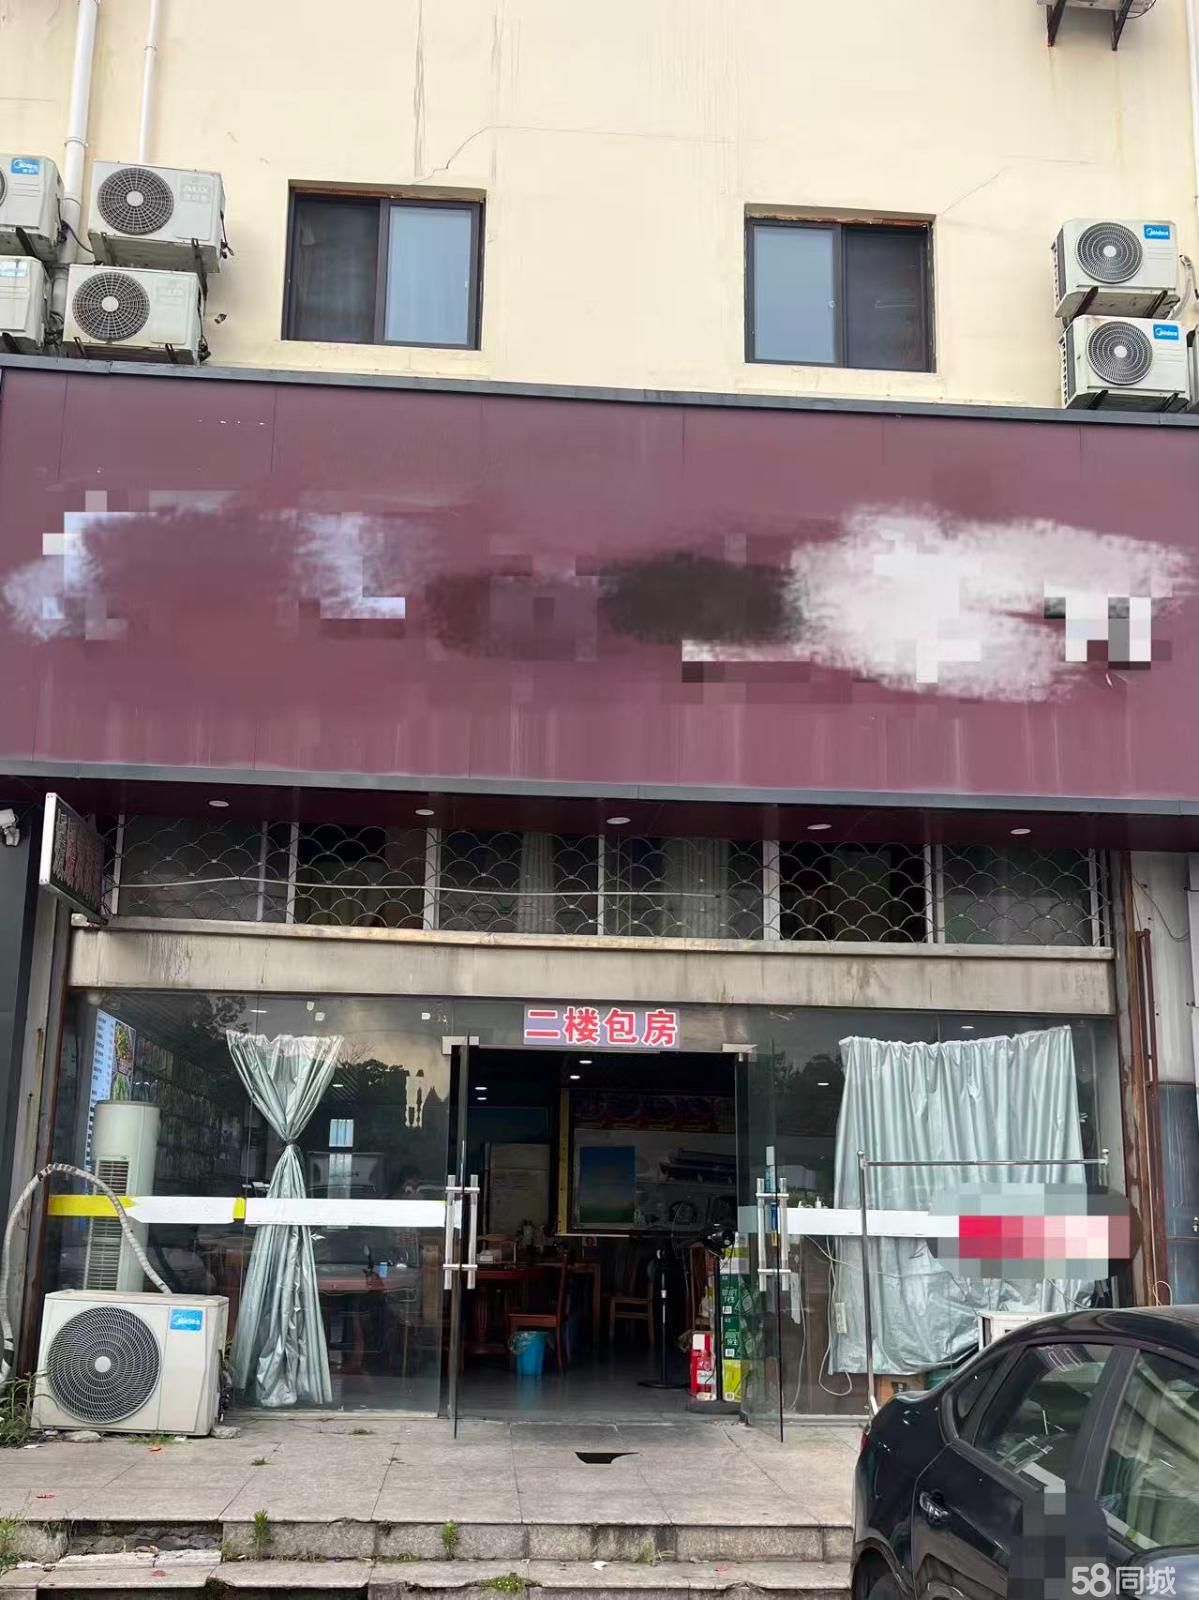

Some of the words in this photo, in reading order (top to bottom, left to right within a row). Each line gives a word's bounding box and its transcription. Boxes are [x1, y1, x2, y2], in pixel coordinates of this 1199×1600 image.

[524, 1006, 678, 1046] 二楼包房
[172, 1313, 200, 1326] Midea
